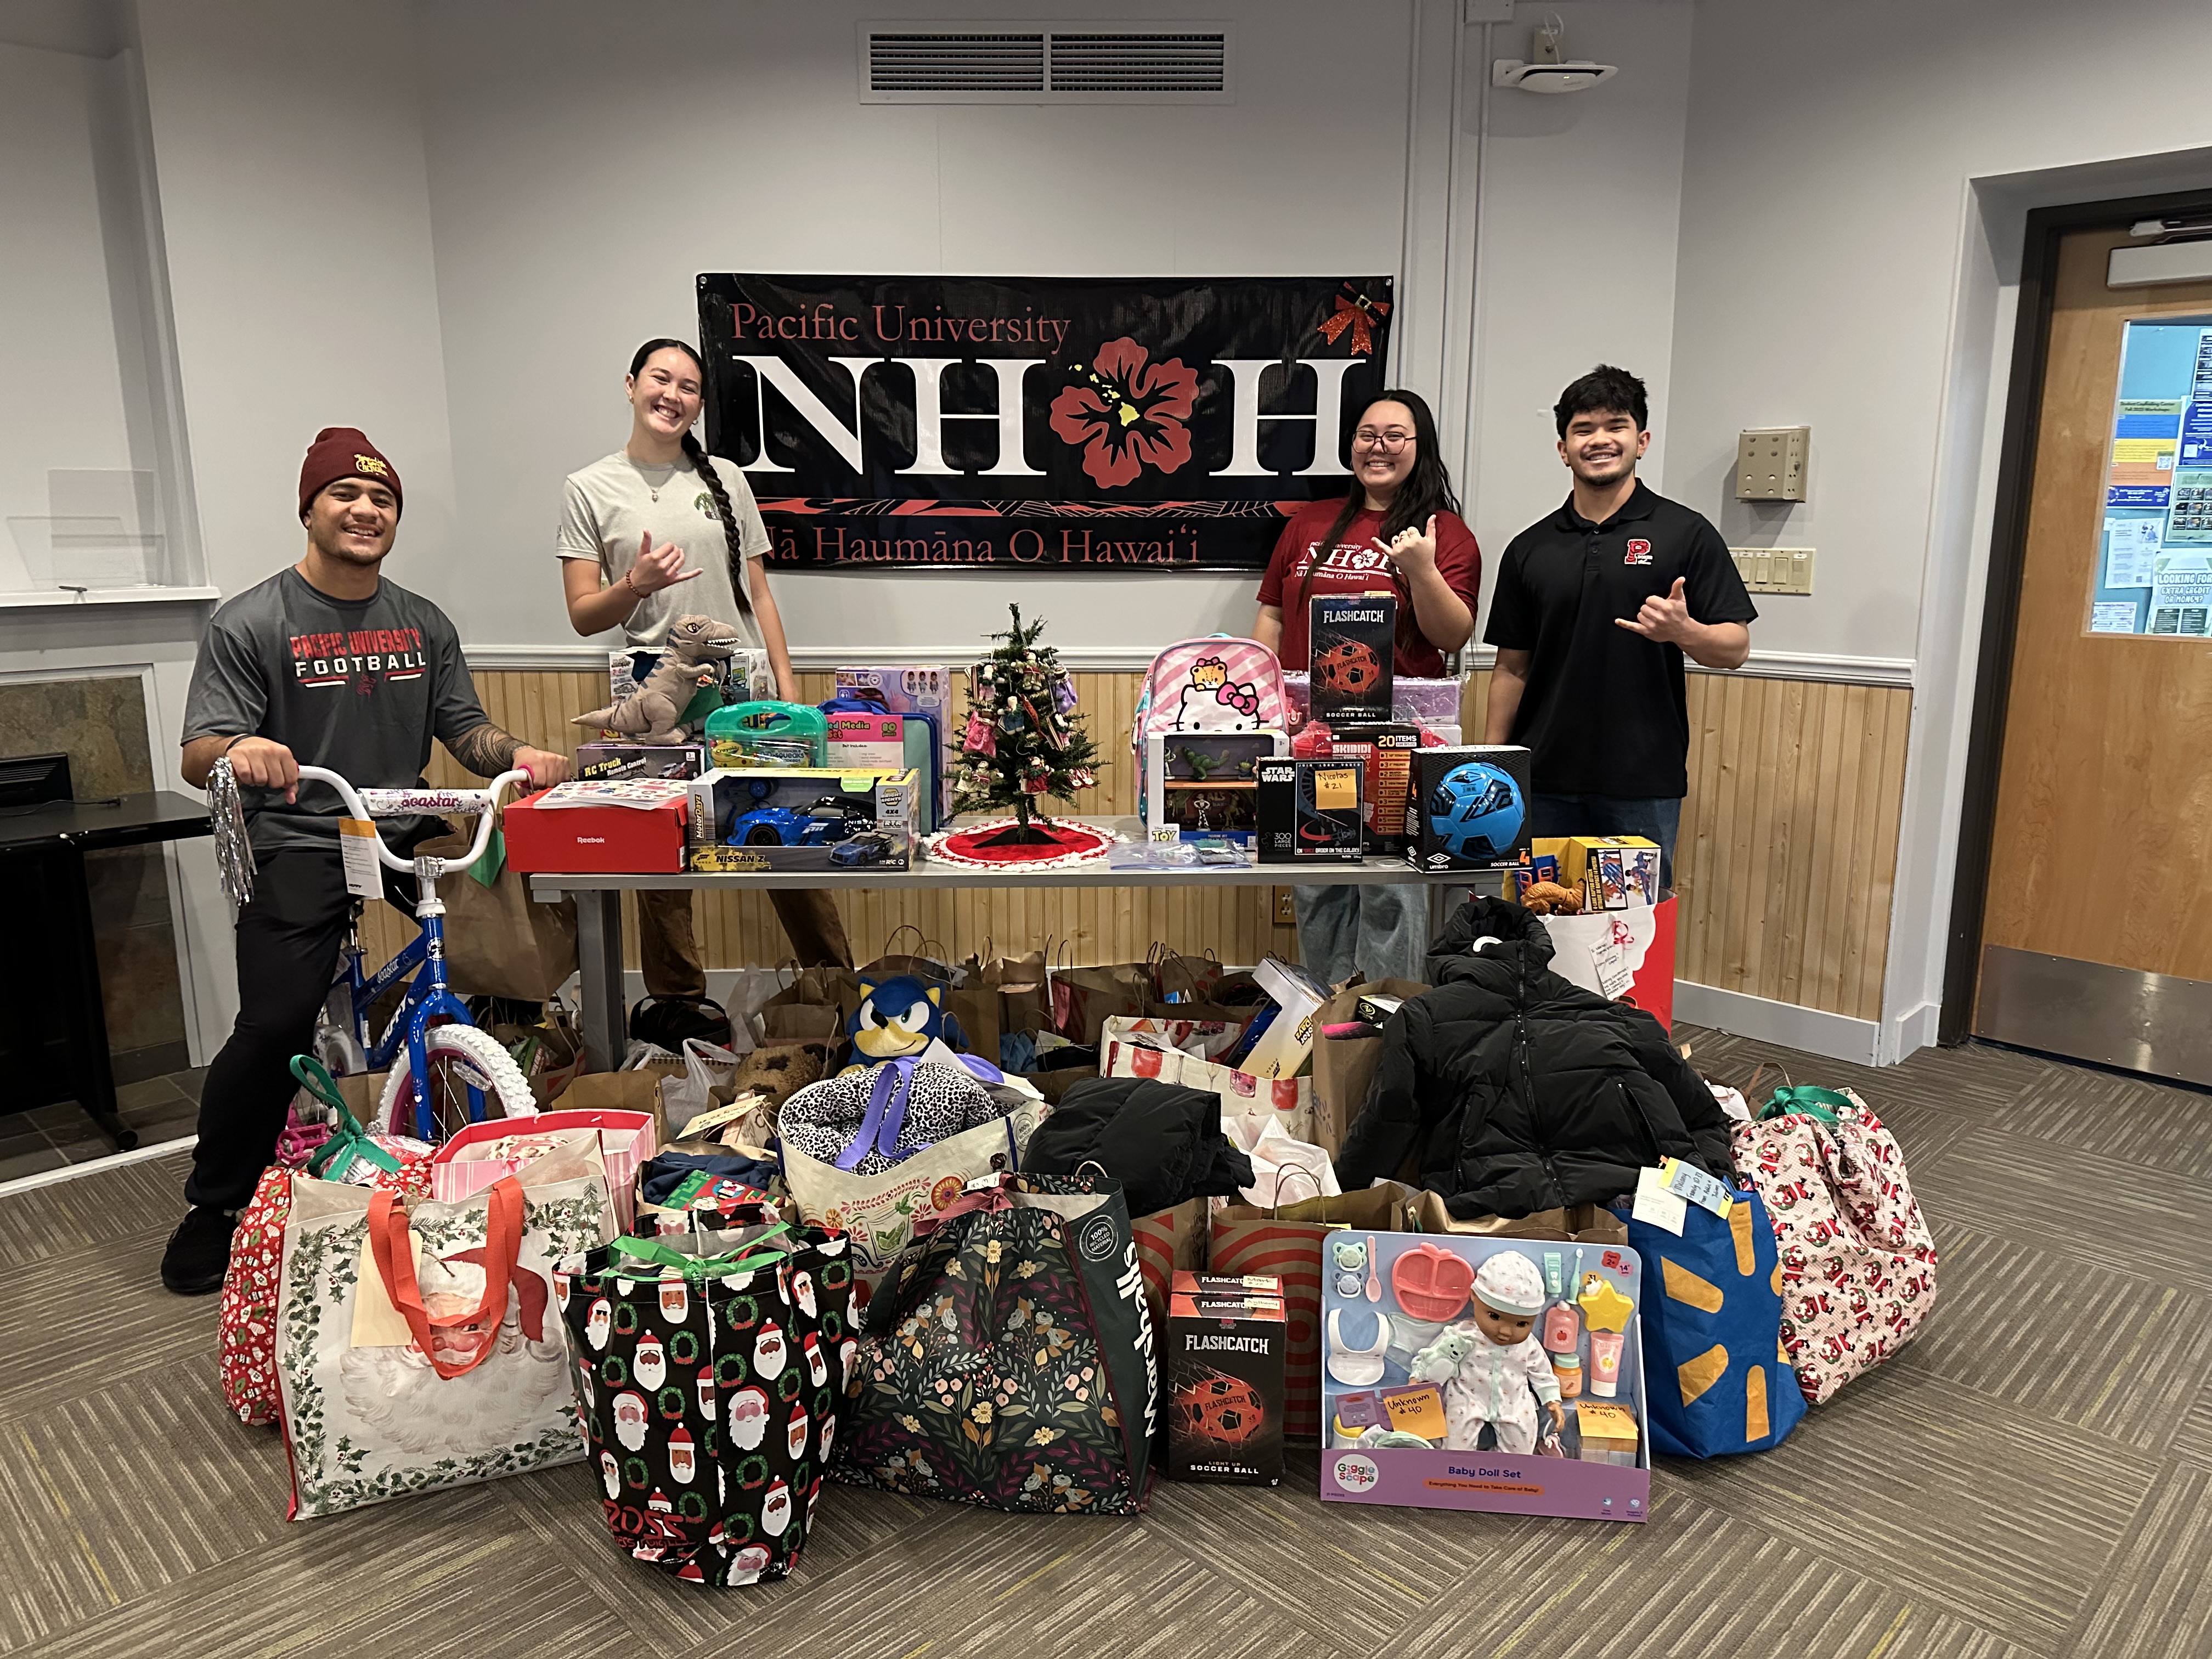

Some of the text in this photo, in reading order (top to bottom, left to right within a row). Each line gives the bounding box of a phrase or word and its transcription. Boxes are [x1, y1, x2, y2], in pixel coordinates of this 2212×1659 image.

[730, 303, 1071, 354] Pacific University
[812, 527, 992, 563] Haumāna
[1009, 529, 1045, 565] O
[1334, 543, 1362, 551] niversity
[1304, 571, 1335, 579] umāna
[2158, 573, 2196, 585] LOOKING
[2162, 586, 2210, 595] EXTRA CREDIT
[1323, 610, 1385, 624] FLASHCATCH
[290, 628, 422, 659] PACIFIC UNIVERSITY
[295, 652, 426, 677] FOOTBALL
[1336, 656, 1367, 670] FLASHCATCH
[842, 720, 870, 730] Media
[882, 722, 897, 732] 80
[827, 730, 843, 739] Set
[1378, 735, 1395, 747] 20
[716, 746, 738, 754] Crayola
[584, 757, 621, 777] RC Truck
[607, 757, 646, 776] Remote Control
[1262, 766, 1295, 775] STAR
[1262, 774, 1295, 782] WARS
[1319, 772, 1348, 781] Nicolas
[695, 794, 704, 839] MotorDayz
[1152, 830, 1177, 841] TOY
[1519, 851, 1530, 865] 4
[1090, 1231, 1110, 1247] RECYCLED
[1091, 1225, 1108, 1240] 100%
[1091, 1237, 1111, 1252] MATERIAL
[1201, 1301, 1246, 1310] FLASHCATC
[1116, 1241, 1158, 1438] Marshalls
[1186, 1335, 1269, 1355] FLASHCATCH
[1205, 1396, 1246, 1411] FLASHCATCH
[1387, 1394, 1430, 1410] Unknown
[1579, 1403, 1626, 1412] Unknown
[1337, 1463, 1375, 1476] Giggle
[1448, 1466, 1521, 1479] Baby Doll Set
[601, 1498, 687, 1540] ROSS
